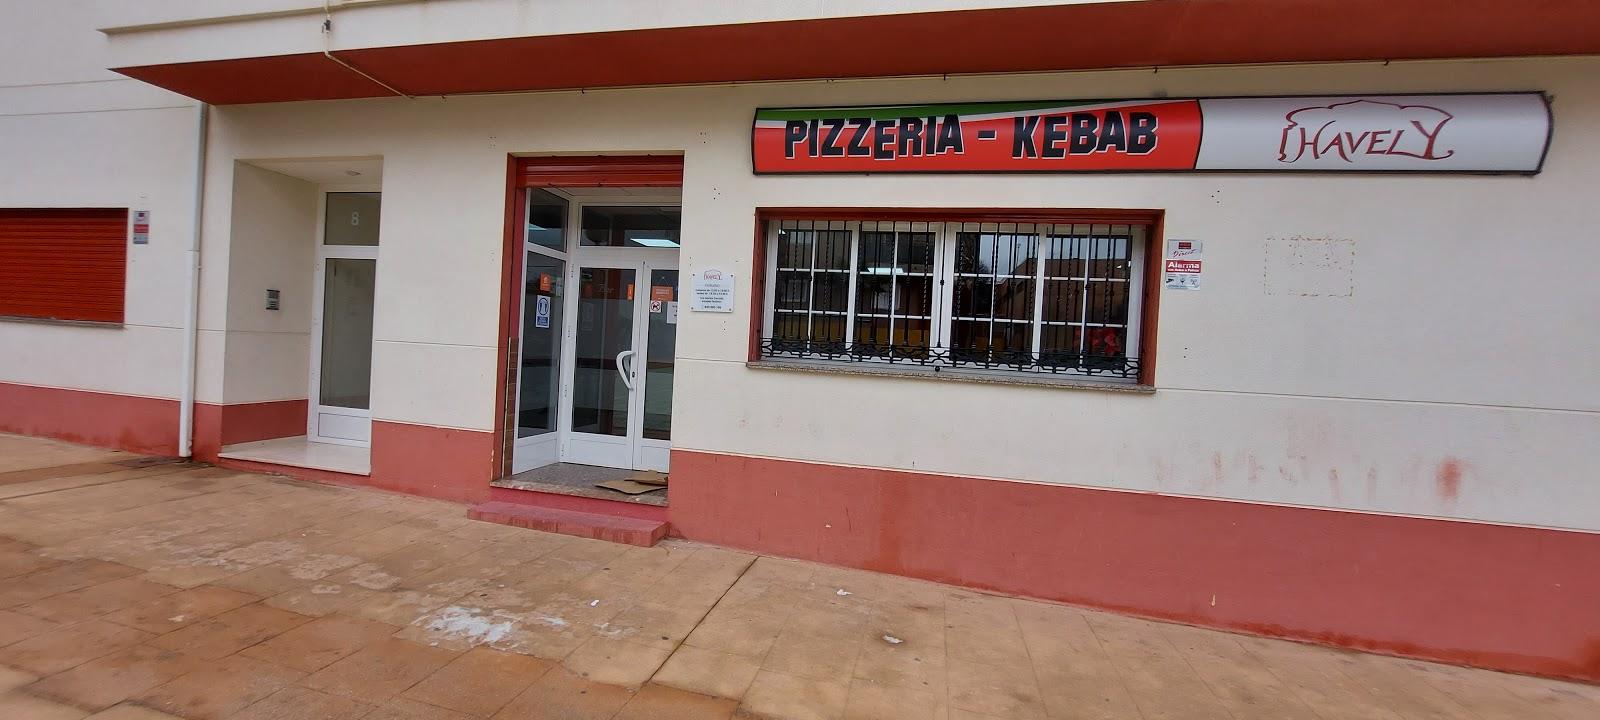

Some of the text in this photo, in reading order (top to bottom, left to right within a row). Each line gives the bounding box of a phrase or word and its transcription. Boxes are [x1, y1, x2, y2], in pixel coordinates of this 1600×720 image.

[784, 110, 1160, 161] PIZZERIA - KEBAB
[1290, 119, 1454, 162] HAVELY
[351, 211, 360, 226] 8
[1168, 261, 1200, 269] Alarma
